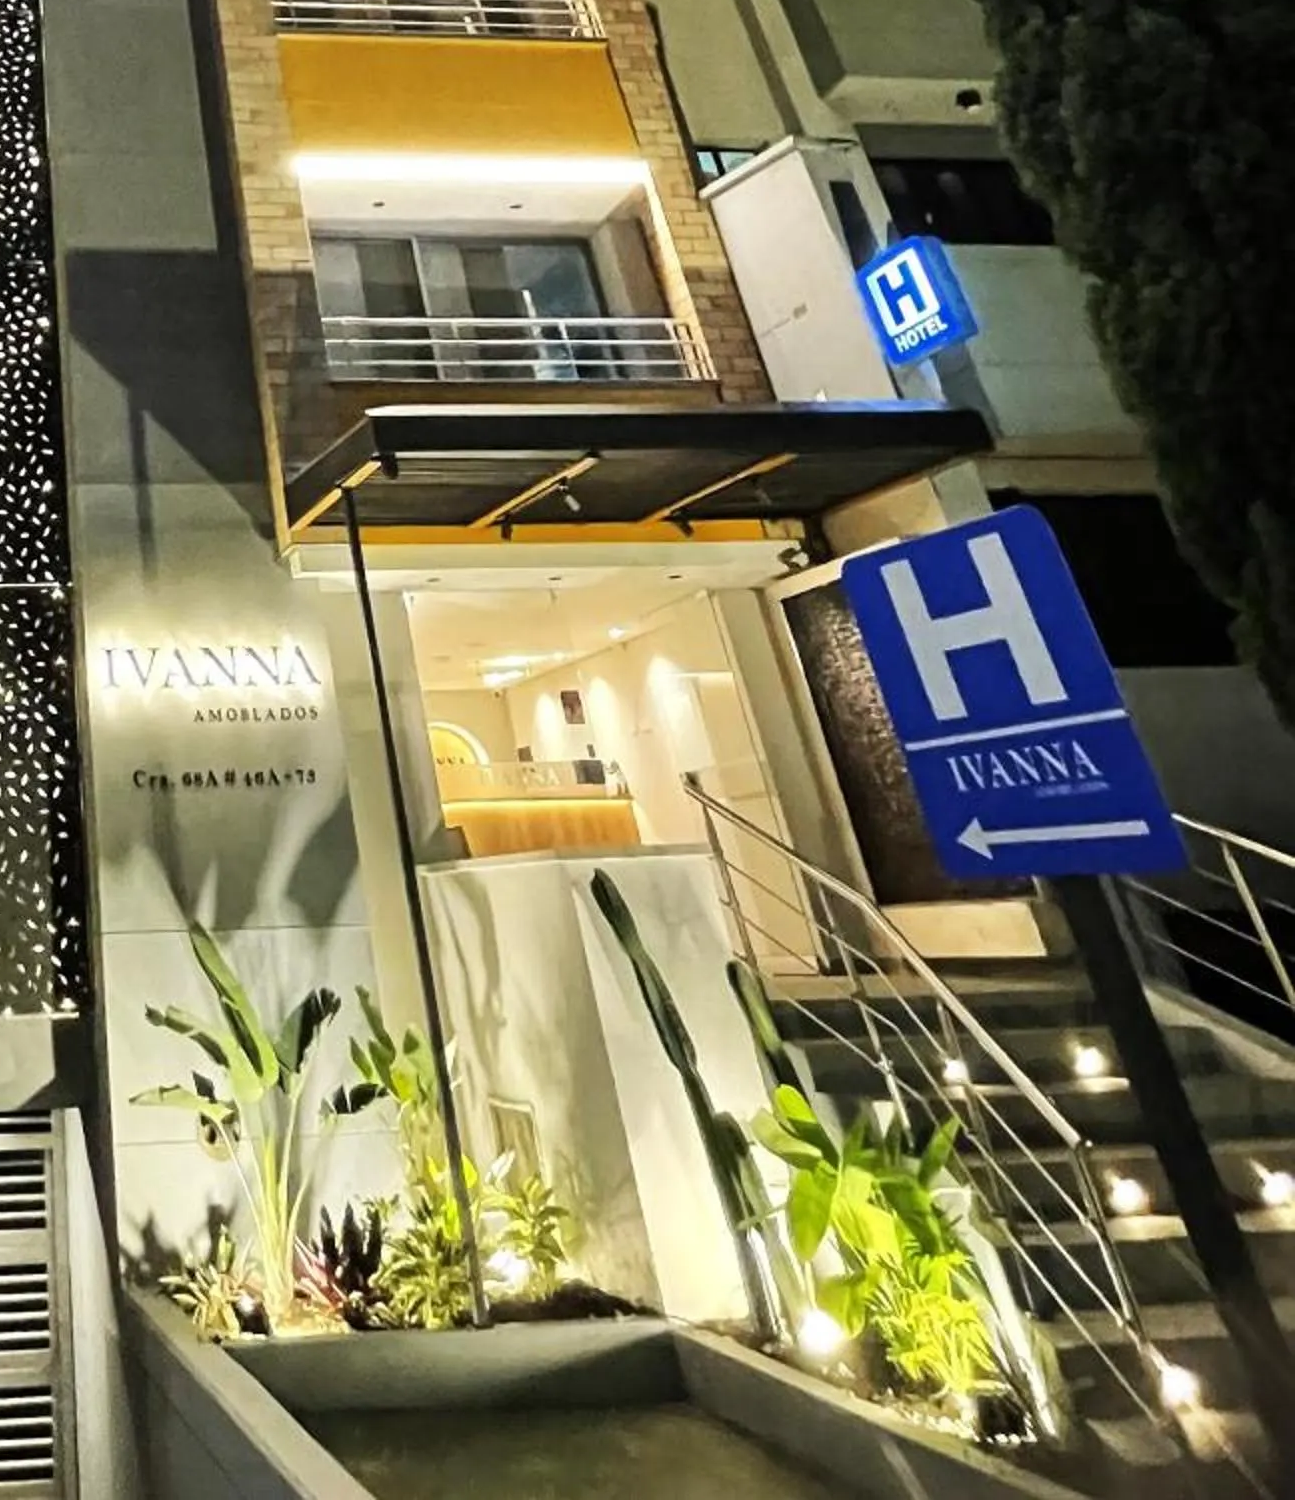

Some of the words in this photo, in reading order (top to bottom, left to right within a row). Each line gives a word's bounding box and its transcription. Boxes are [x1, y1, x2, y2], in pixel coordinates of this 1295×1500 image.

[876, 259, 927, 327] H
[893, 314, 948, 353] HOTEL
[880, 531, 1068, 721] H
[103, 646, 322, 688] IVANNA
[193, 706, 319, 723] AMOBLADOS
[946, 741, 1103, 792] IVANNA
